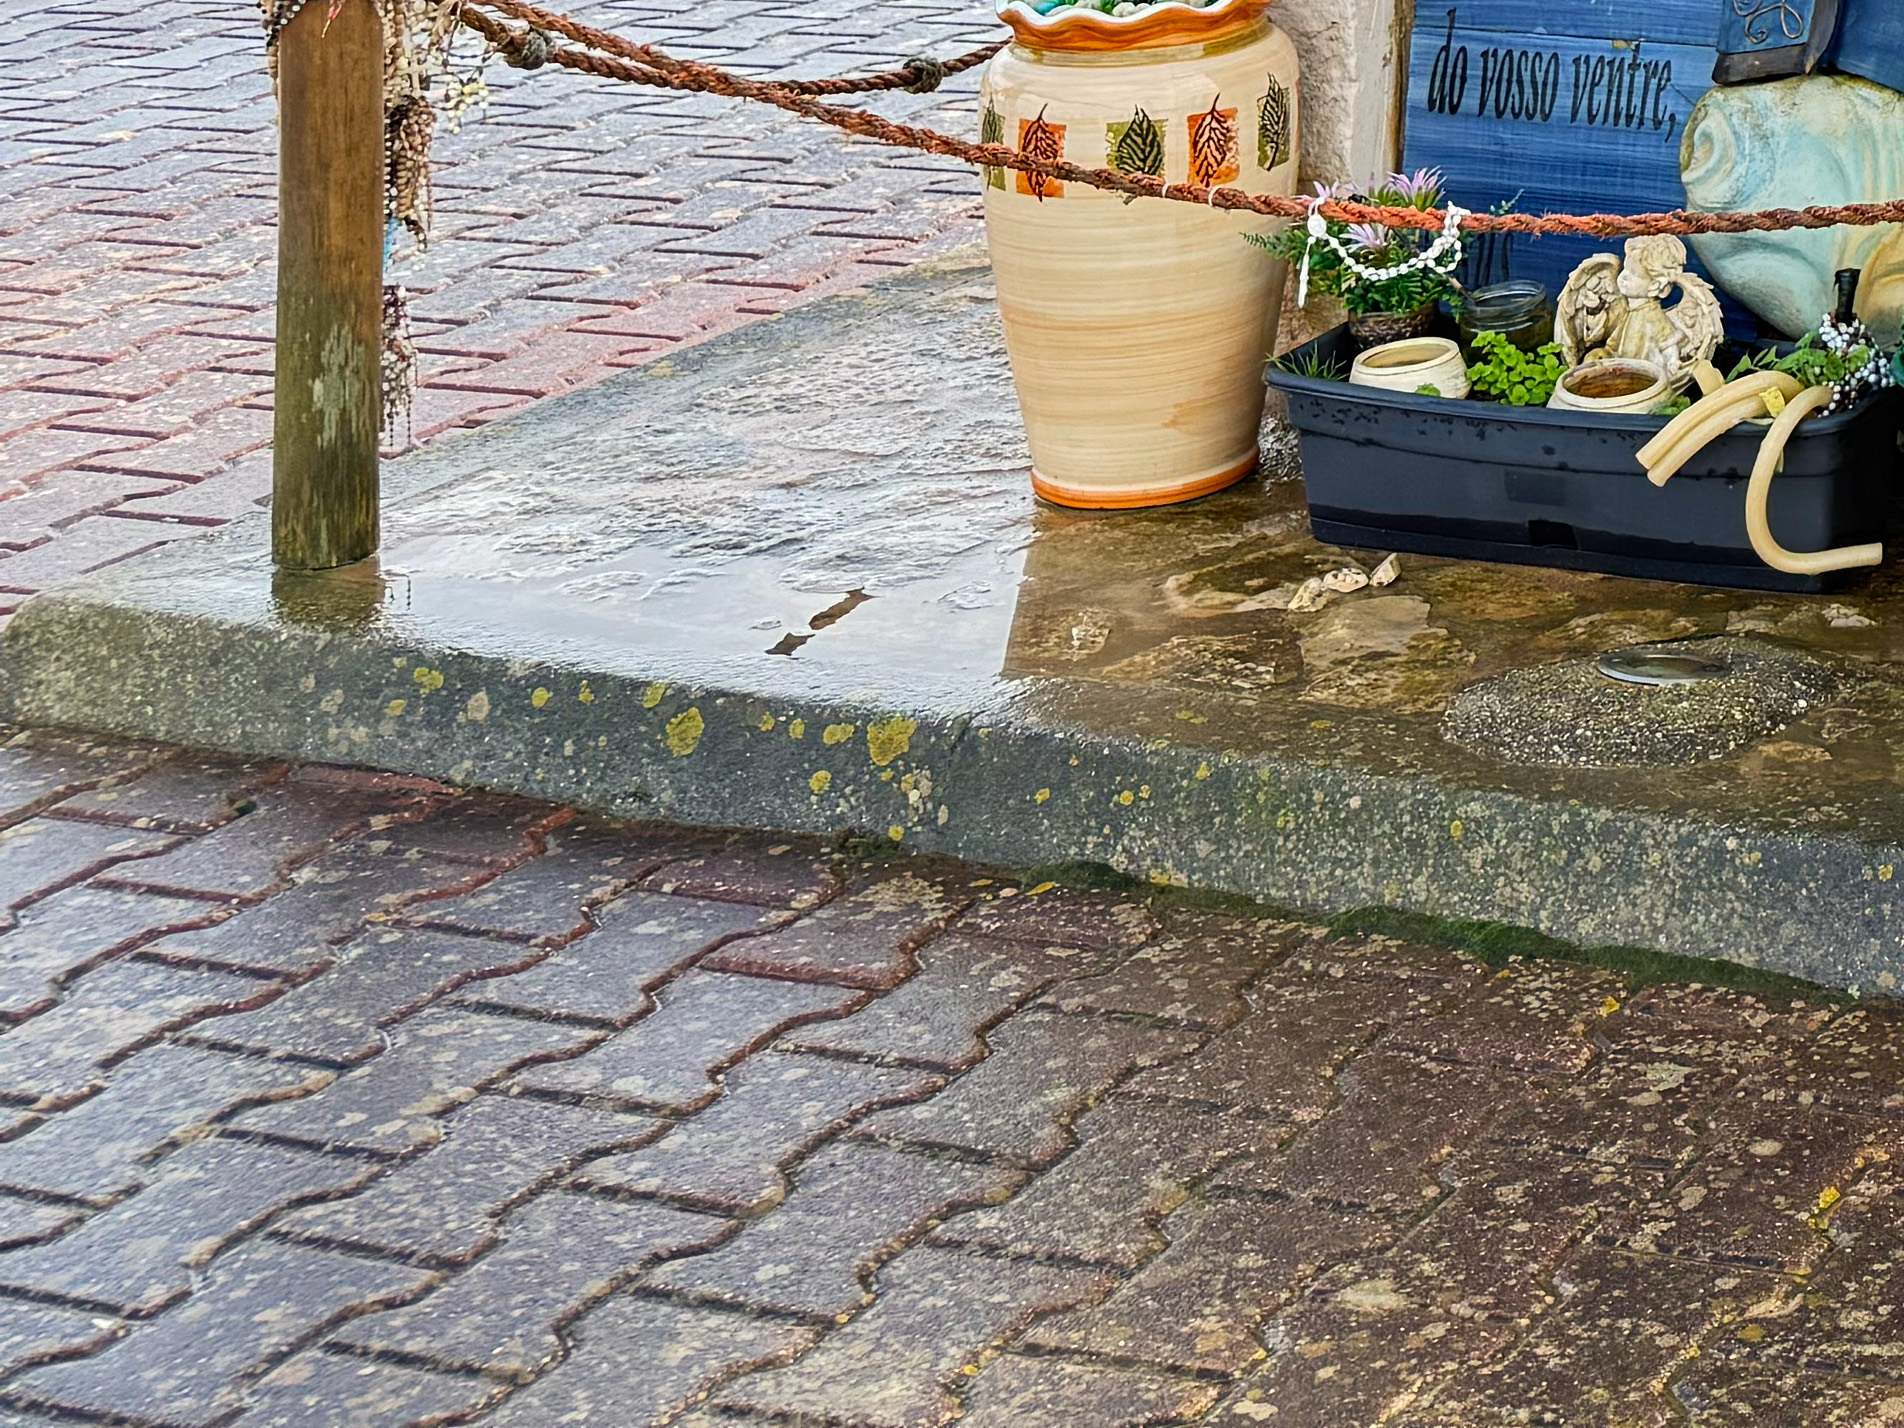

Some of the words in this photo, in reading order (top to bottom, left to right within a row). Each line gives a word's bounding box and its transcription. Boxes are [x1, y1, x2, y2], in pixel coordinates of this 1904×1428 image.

[1427, 7, 1468, 115] do
[1477, 45, 1560, 122] vosso
[1569, 41, 1677, 143] ventre,
